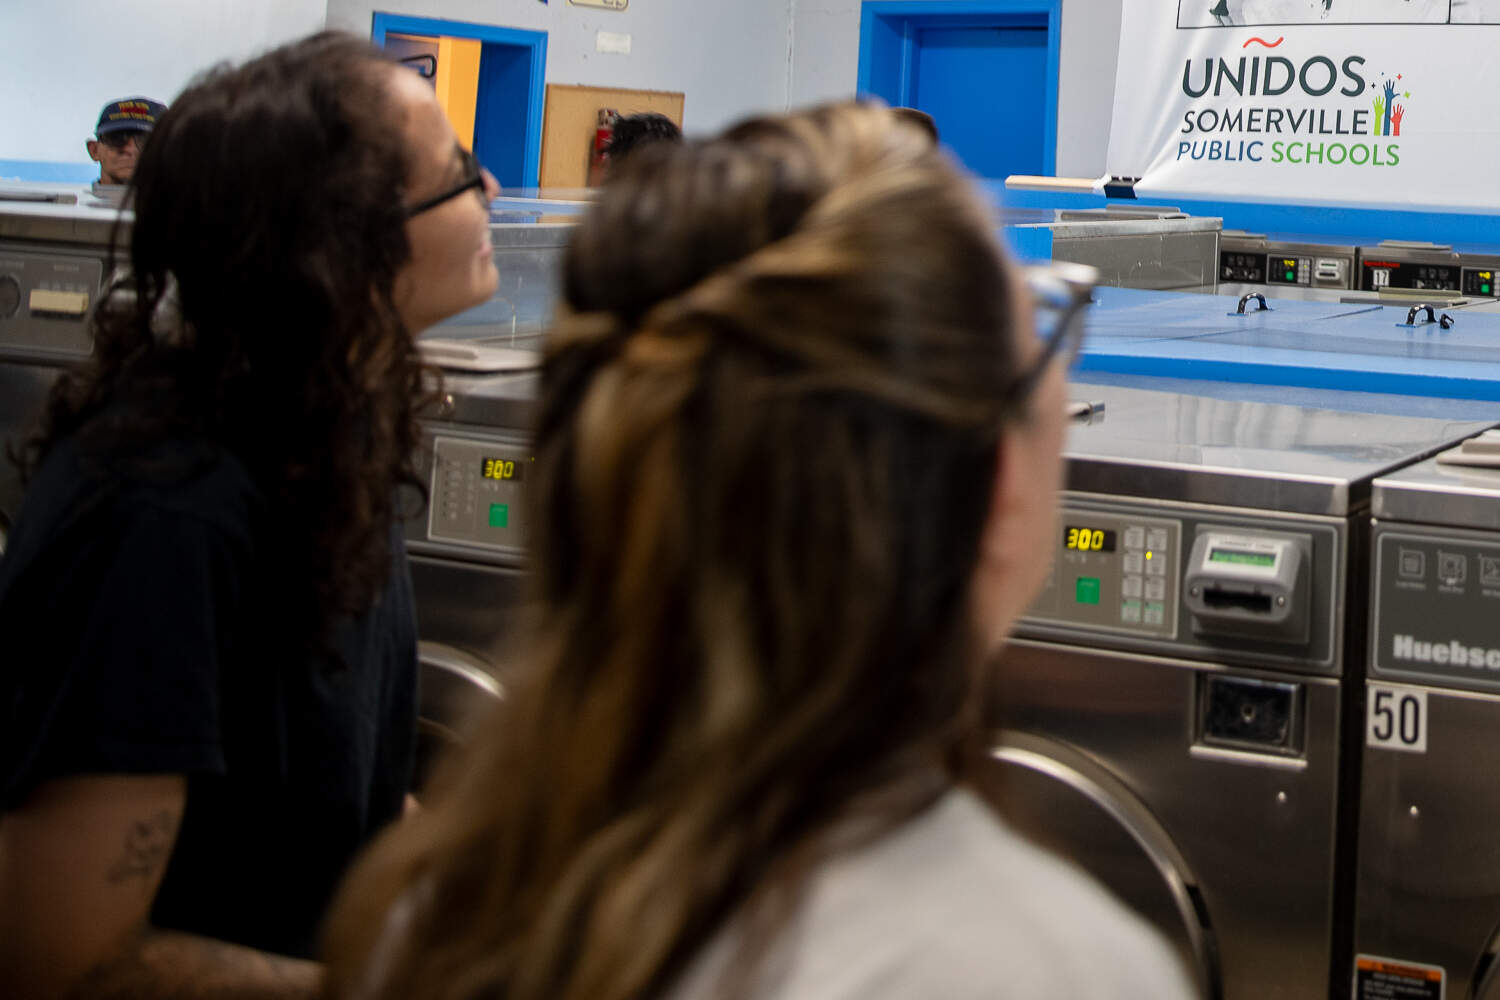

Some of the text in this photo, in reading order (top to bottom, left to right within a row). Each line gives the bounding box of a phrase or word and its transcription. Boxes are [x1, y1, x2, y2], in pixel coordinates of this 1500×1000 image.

[1182, 55, 1366, 98] UNIDOS
[1181, 108, 1369, 135] SOMERVILLE
[1177, 140, 1400, 166] PUBLIC SCHOOLS
[1376, 271, 1388, 286] 17
[485, 458, 514, 480] 300
[1066, 527, 1104, 551] 300
[1373, 690, 1420, 745] 50
